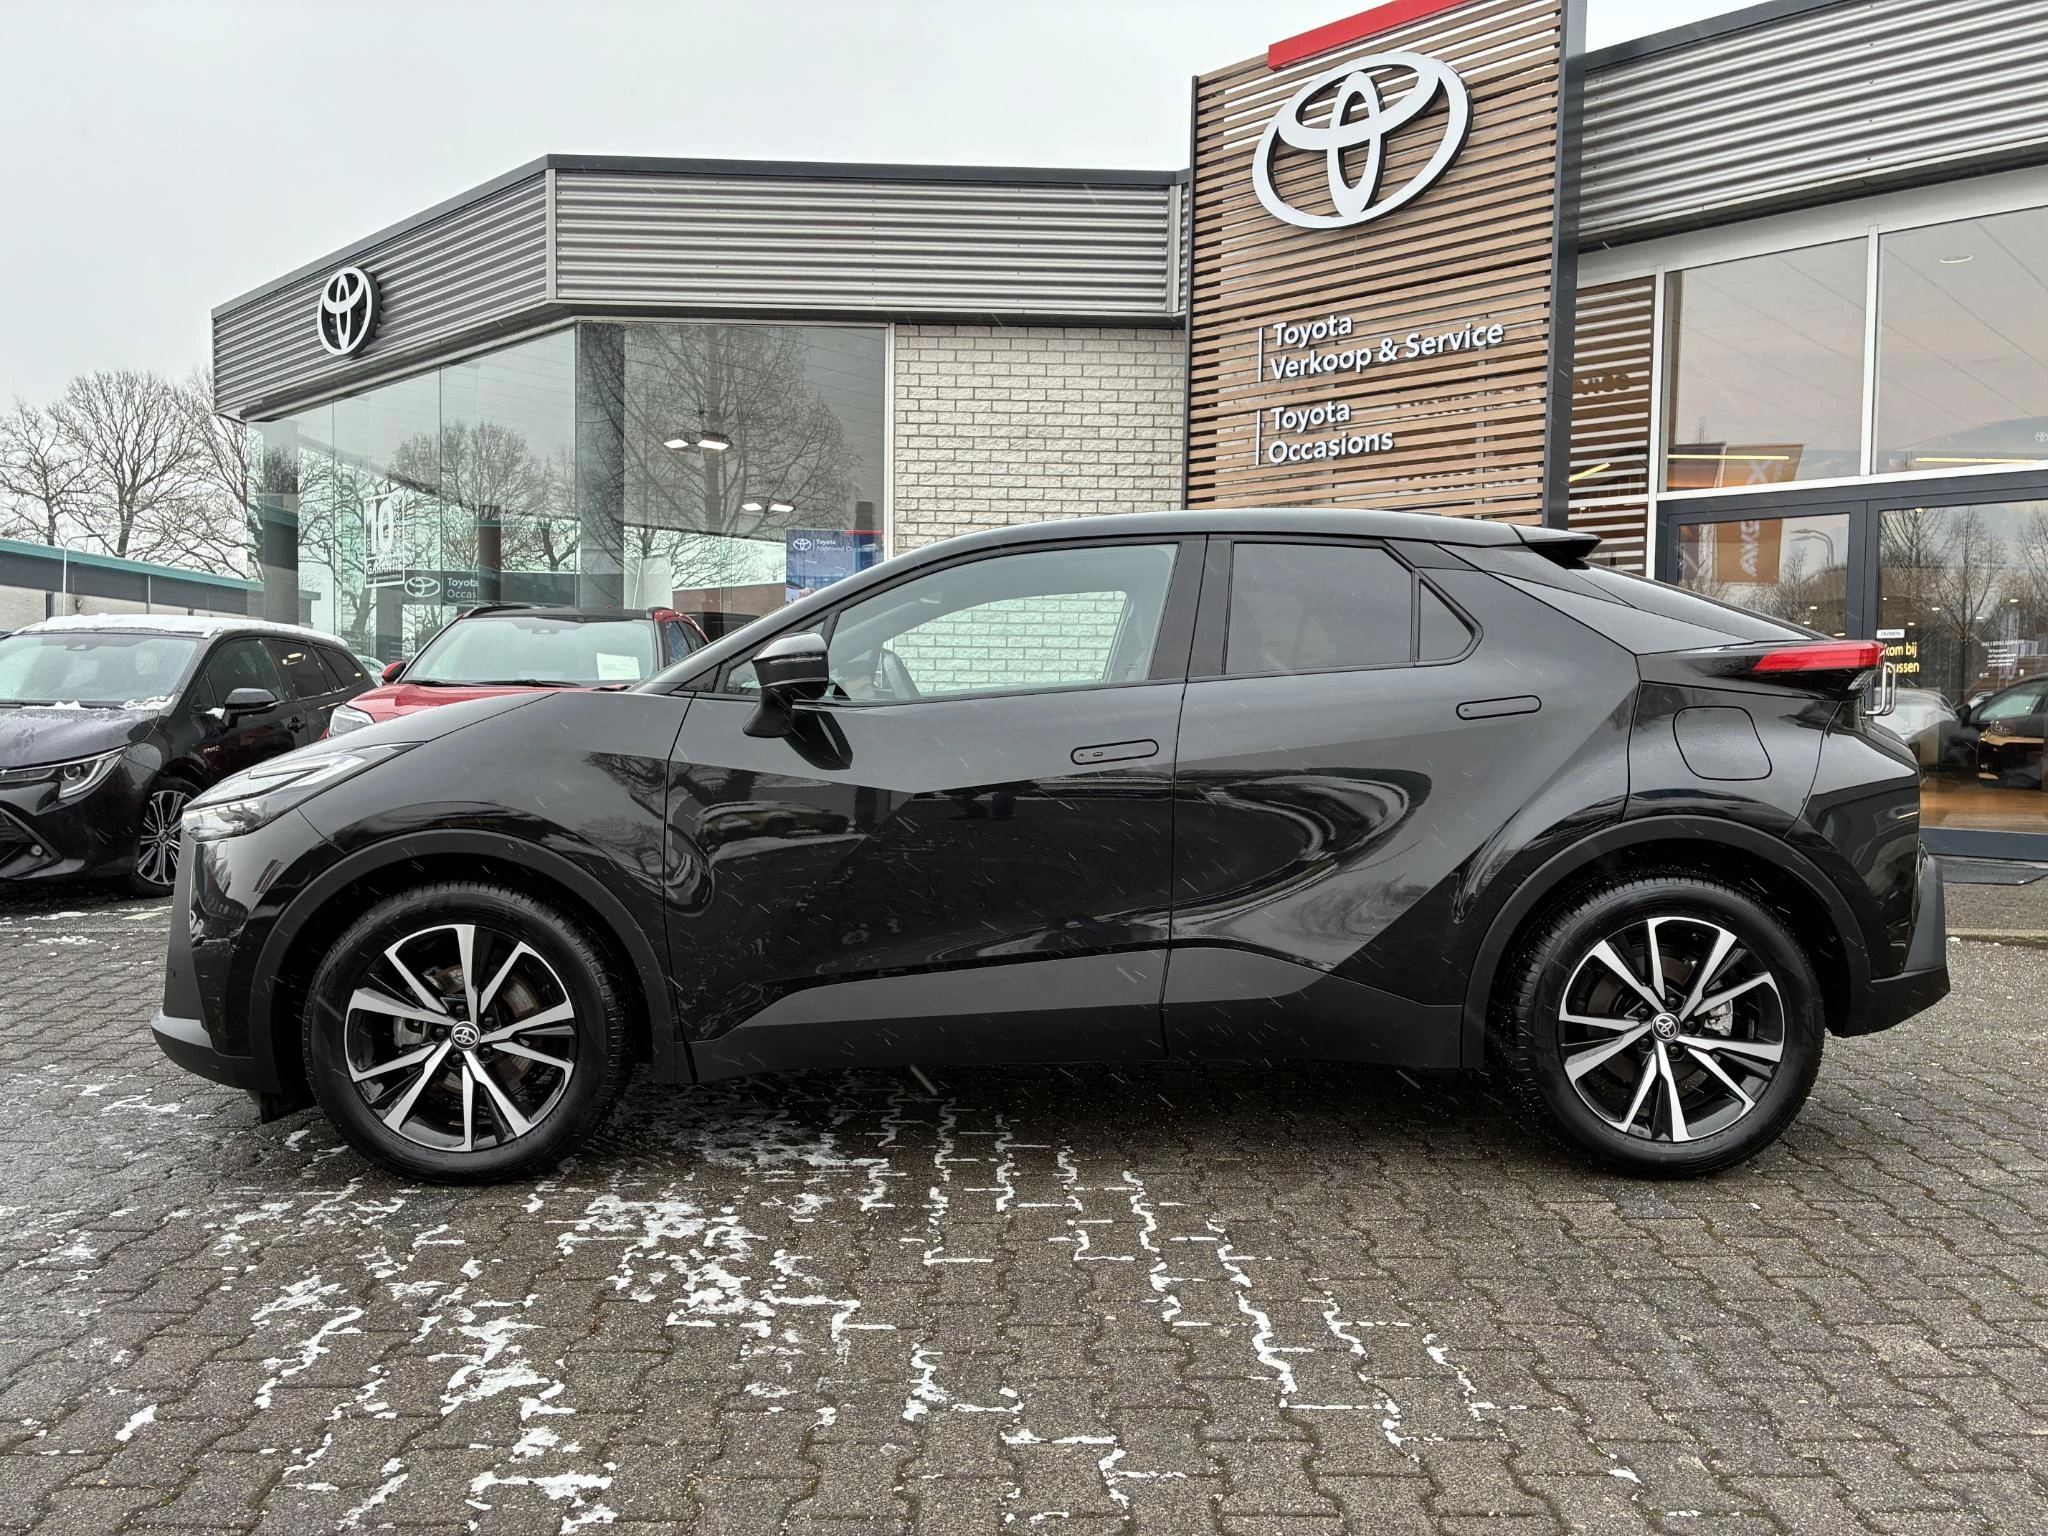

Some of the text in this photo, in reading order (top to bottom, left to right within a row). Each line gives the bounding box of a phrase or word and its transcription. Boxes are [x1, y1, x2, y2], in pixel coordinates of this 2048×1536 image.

[1272, 314, 1353, 349] Toyota
[1270, 321, 1505, 381] Verkoop & Service
[1270, 401, 1351, 434] Toyota
[1268, 431, 1395, 464] Occasions
[816, 538, 836, 546] Toyota
[447, 577, 479, 589] Toyota
[447, 589, 477, 599] Occas
[1884, 641, 1918, 659] kom bij
